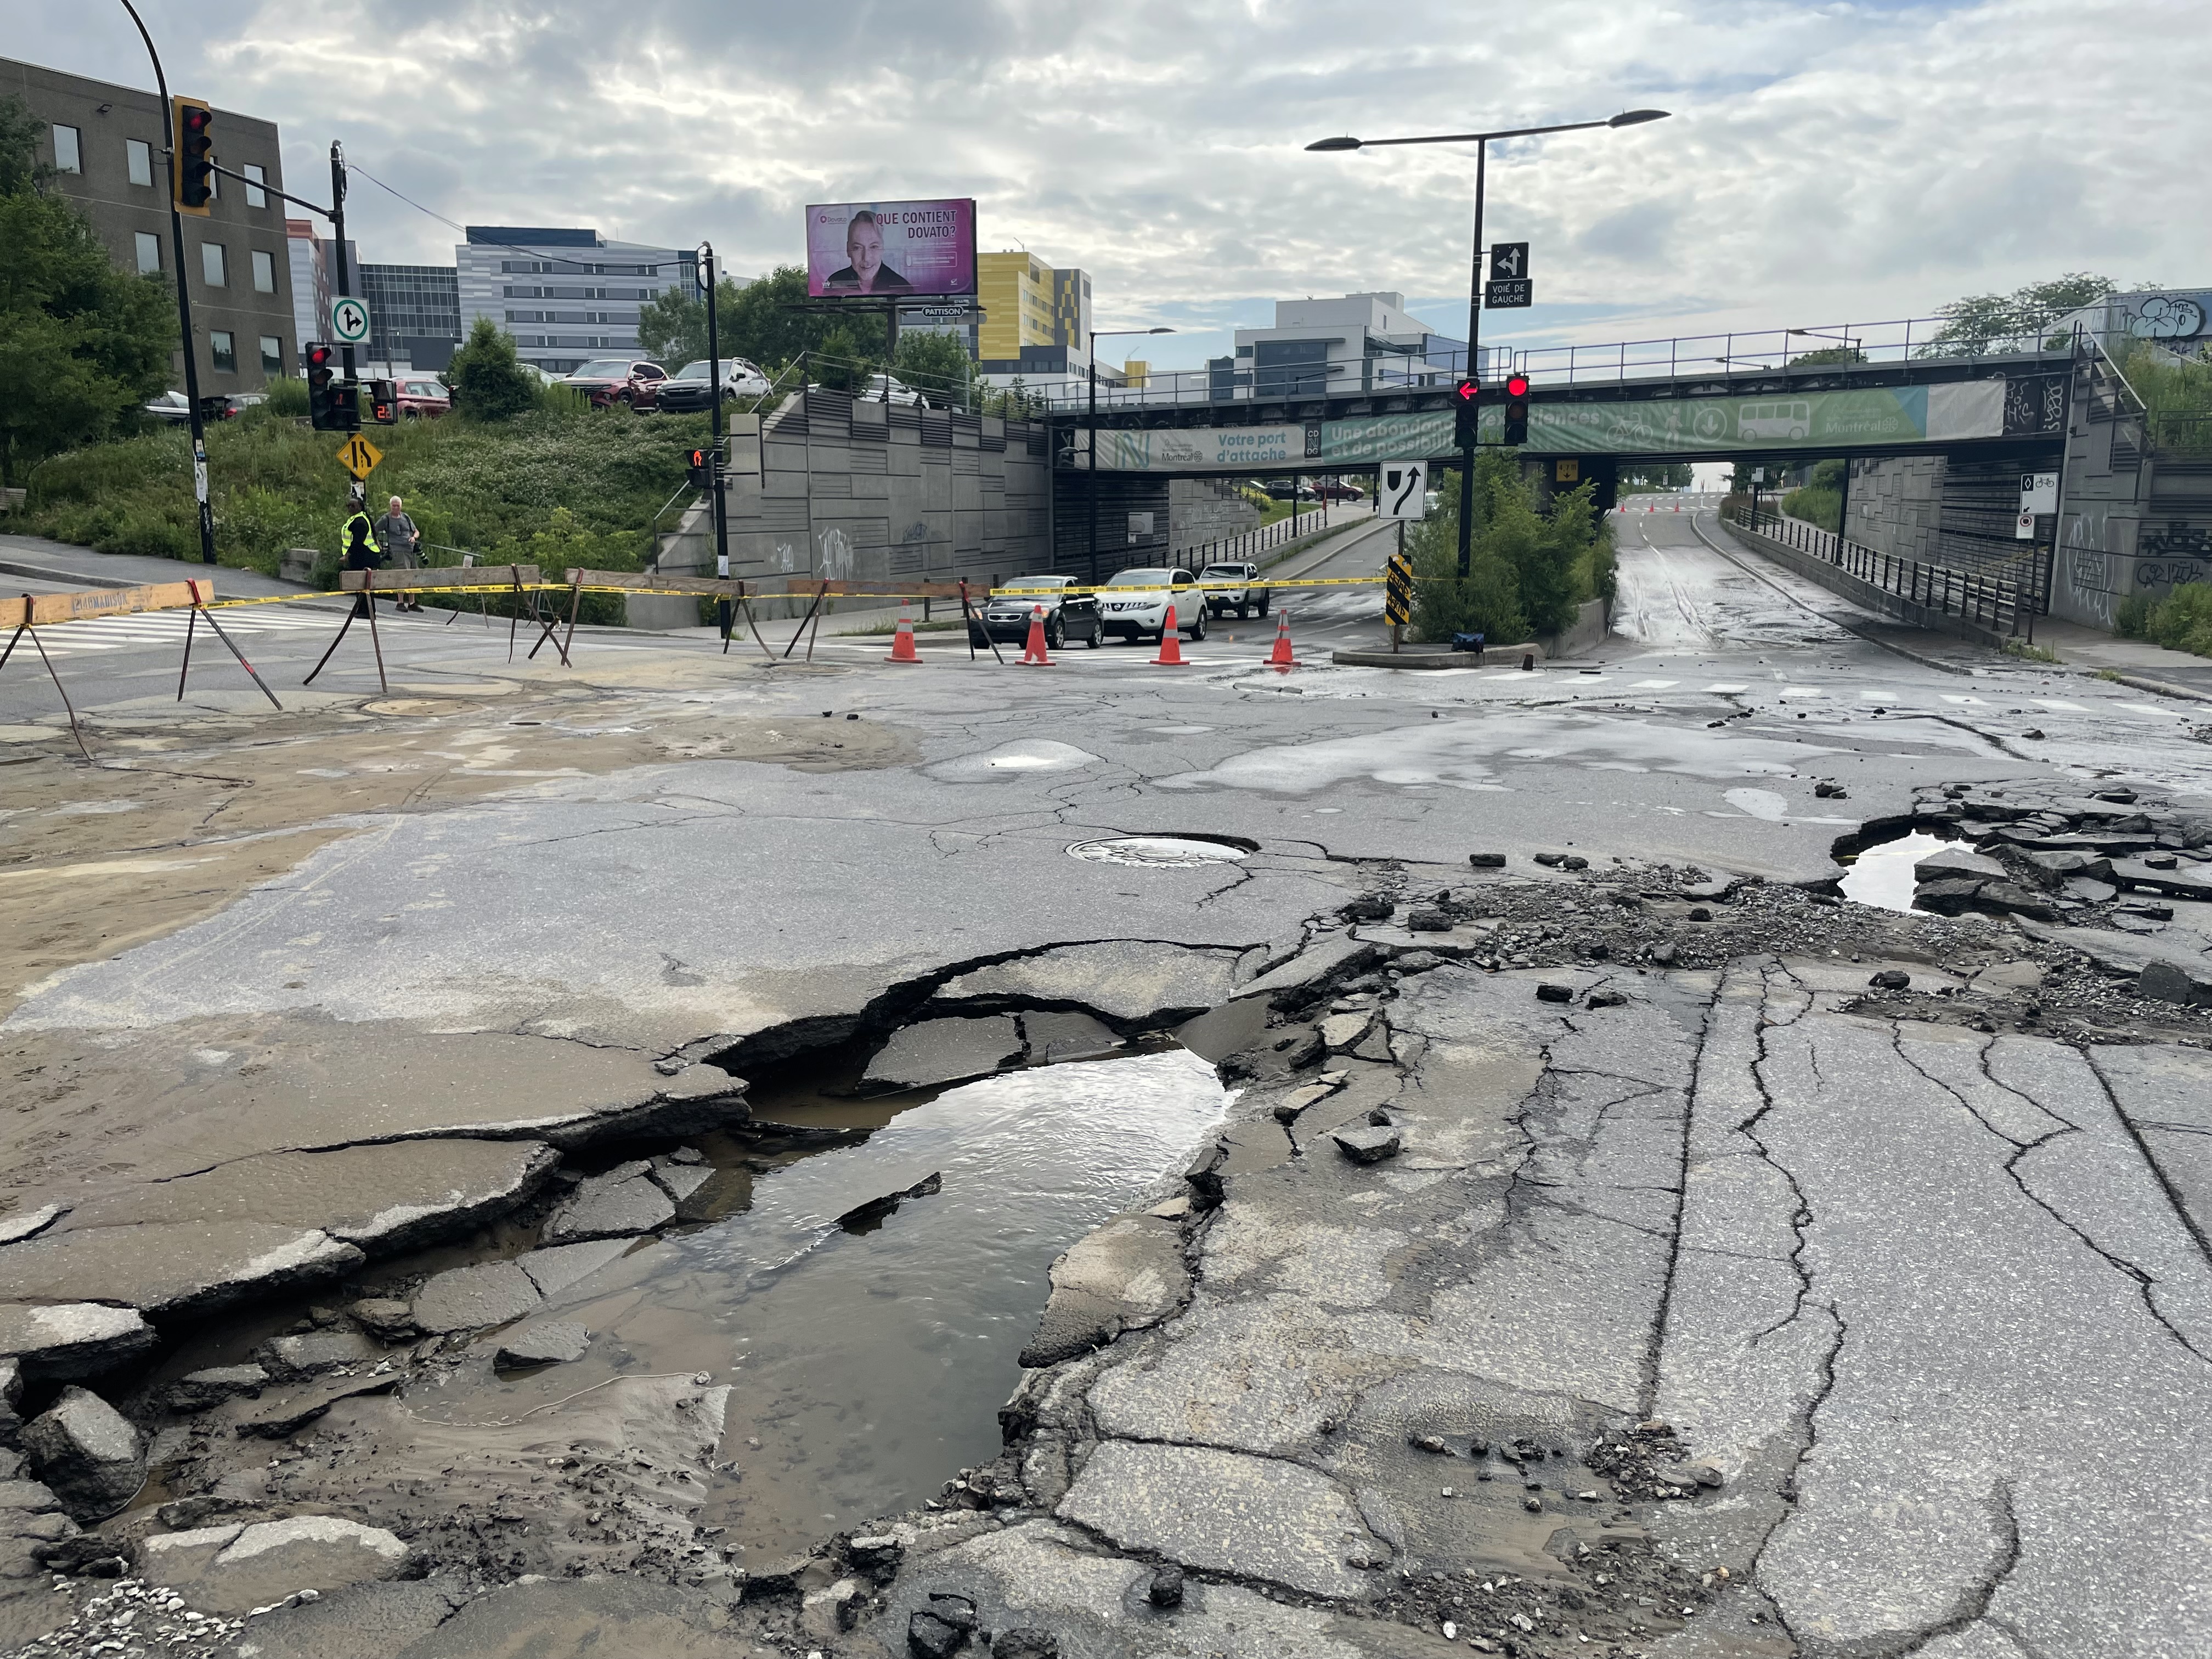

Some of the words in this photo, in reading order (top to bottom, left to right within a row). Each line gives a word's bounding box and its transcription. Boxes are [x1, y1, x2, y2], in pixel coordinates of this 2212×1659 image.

[876, 212, 899, 227] QUE
[902, 210, 956, 224] CONTIENT
[908, 225, 956, 239] DOVATO?
[1492, 285, 1510, 294] VOIE
[1515, 284, 1525, 292] DE
[1492, 295, 1525, 303] GAUCHE
[1331, 426, 1363, 440] Une
[1365, 419, 1455, 436] abondanc
[1826, 420, 1881, 433] Montréal
[1218, 435, 1255, 447] Votre
[1258, 431, 1286, 448] port
[1217, 447, 1286, 462] d'attache
[1331, 444, 1348, 457] et
[1352, 441, 1372, 455] de
[1161, 453, 1193, 461] Montréal
